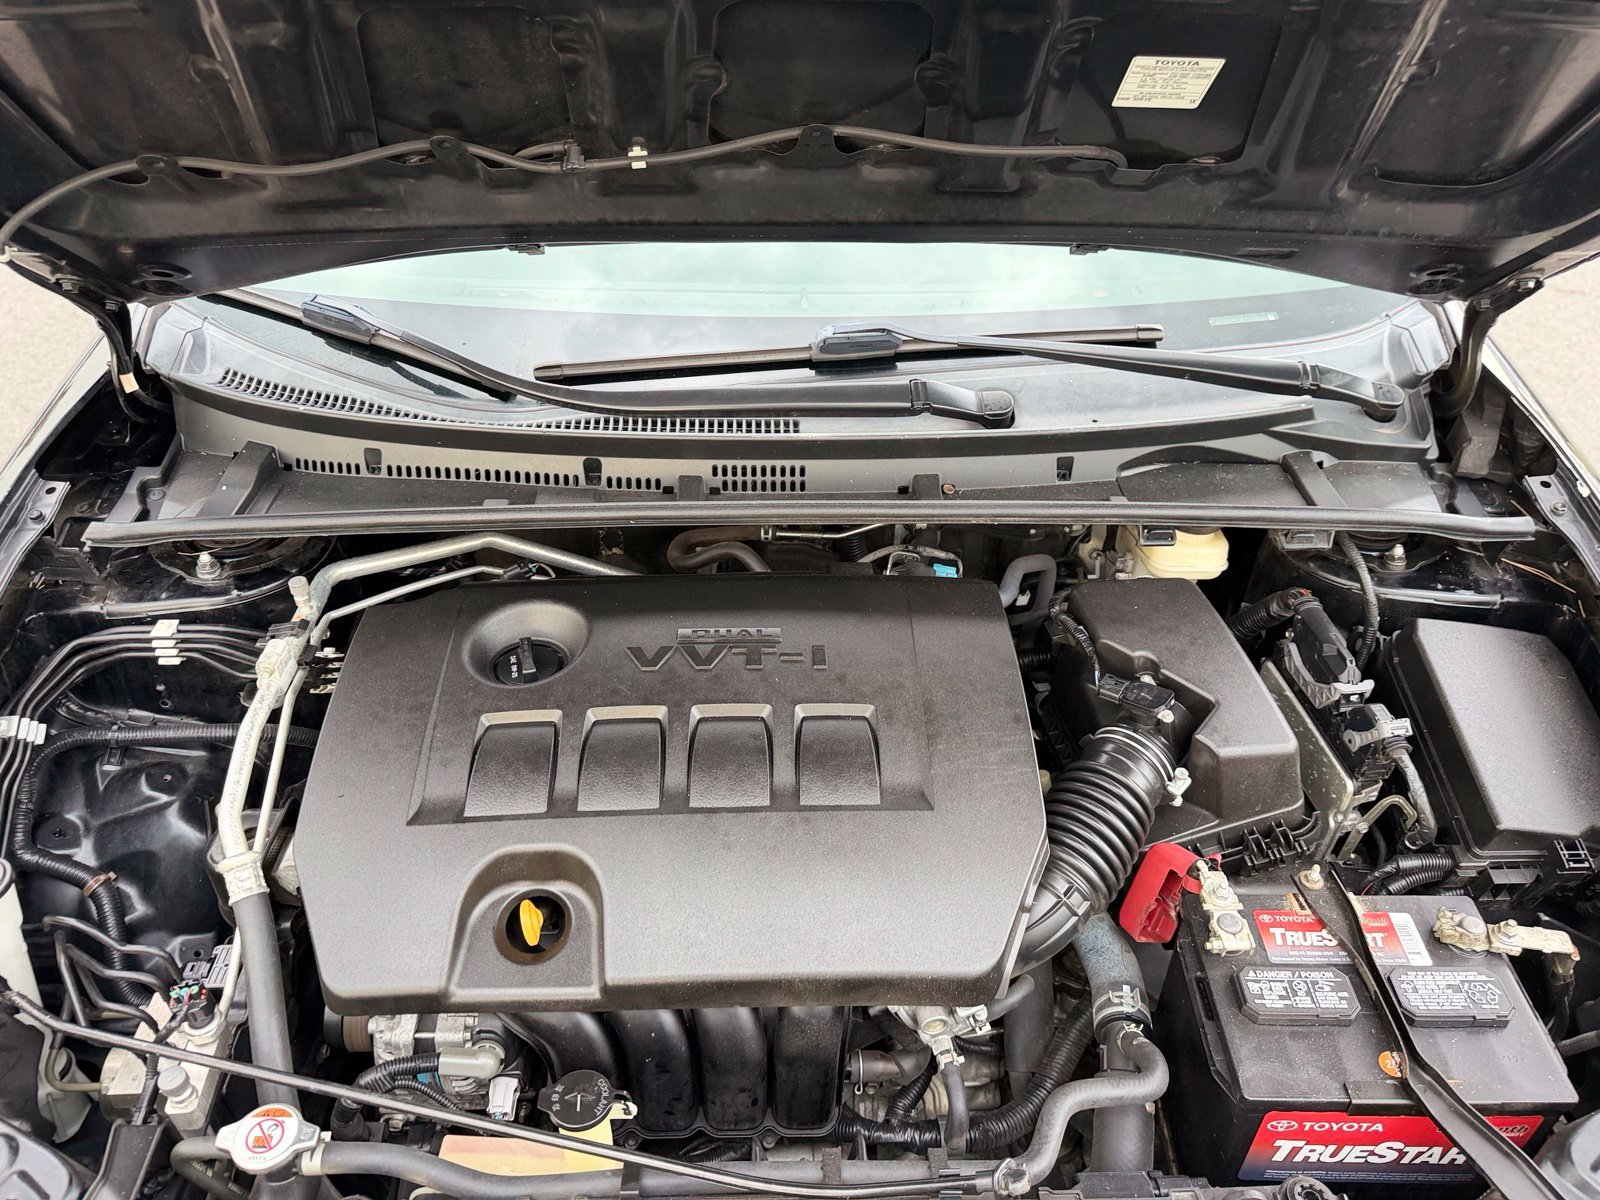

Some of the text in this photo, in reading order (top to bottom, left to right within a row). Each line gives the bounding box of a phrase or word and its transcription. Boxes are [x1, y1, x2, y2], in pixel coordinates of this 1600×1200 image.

[691, 628, 774, 639] DUAL
[1276, 915, 1312, 923] TOYOTA
[1269, 927, 1385, 947] TRUESRT
[1255, 970, 1293, 979] DANGER
[1300, 971, 1334, 979] POISON
[594, 1078, 610, 1116] COOLANT
[1302, 1121, 1384, 1133] TOYOTA
